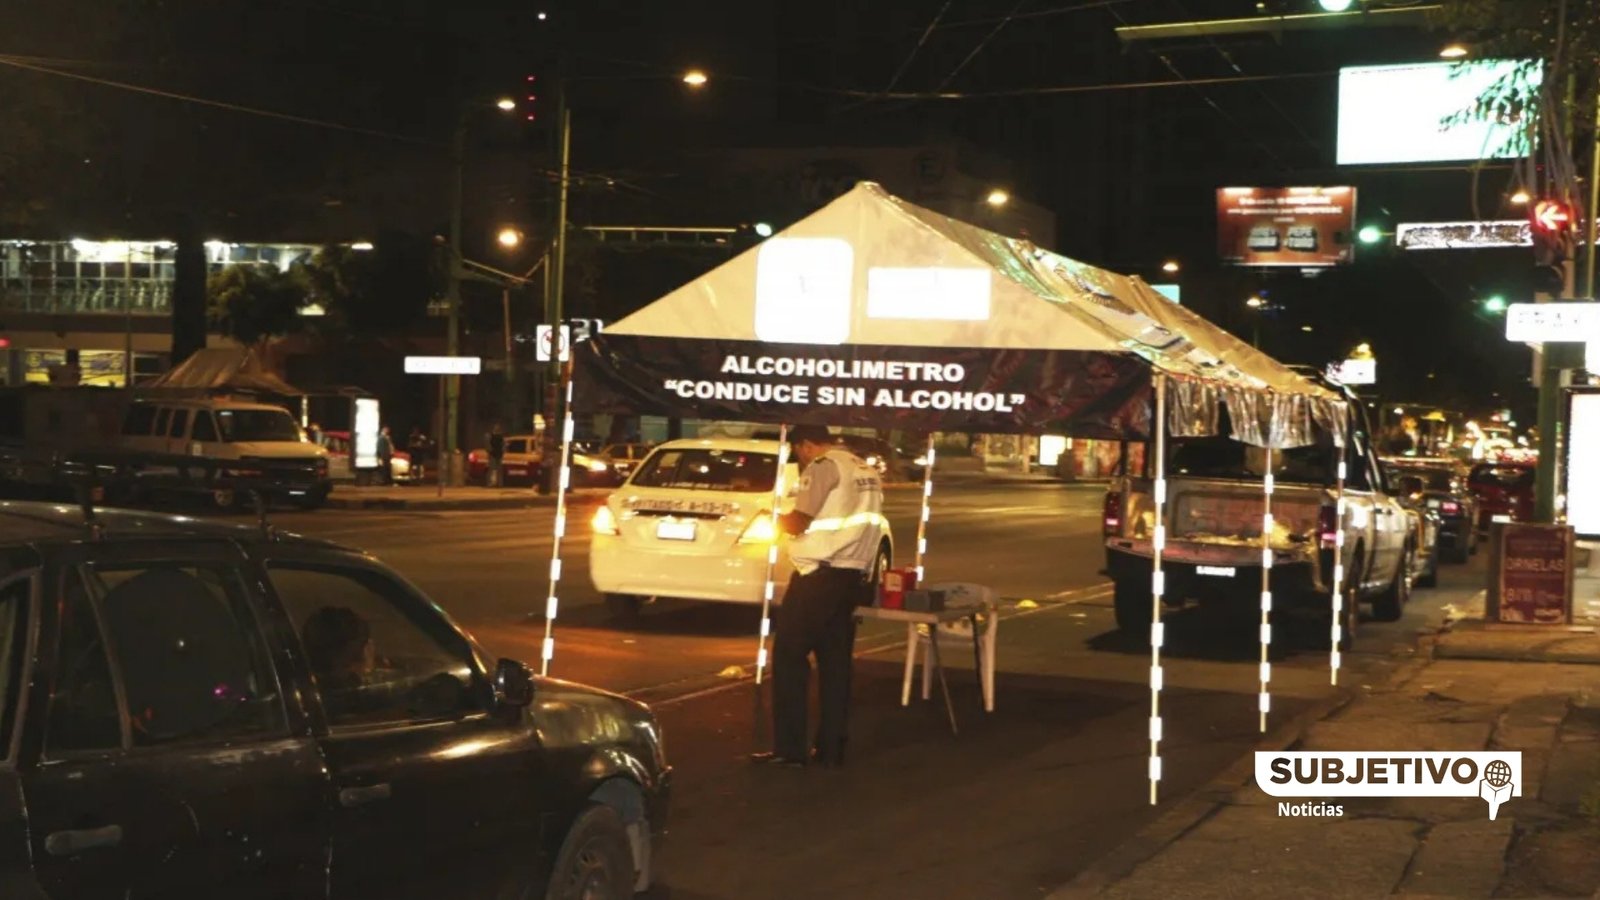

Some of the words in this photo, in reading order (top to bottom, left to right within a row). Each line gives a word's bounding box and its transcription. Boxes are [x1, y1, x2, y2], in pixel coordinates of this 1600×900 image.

[721, 355, 965, 384] ALCOHOLIMETRO
[665, 379, 810, 405] “CONDUCE
[817, 386, 866, 406] SIN
[874, 388, 1025, 413] ALCOHOL”
